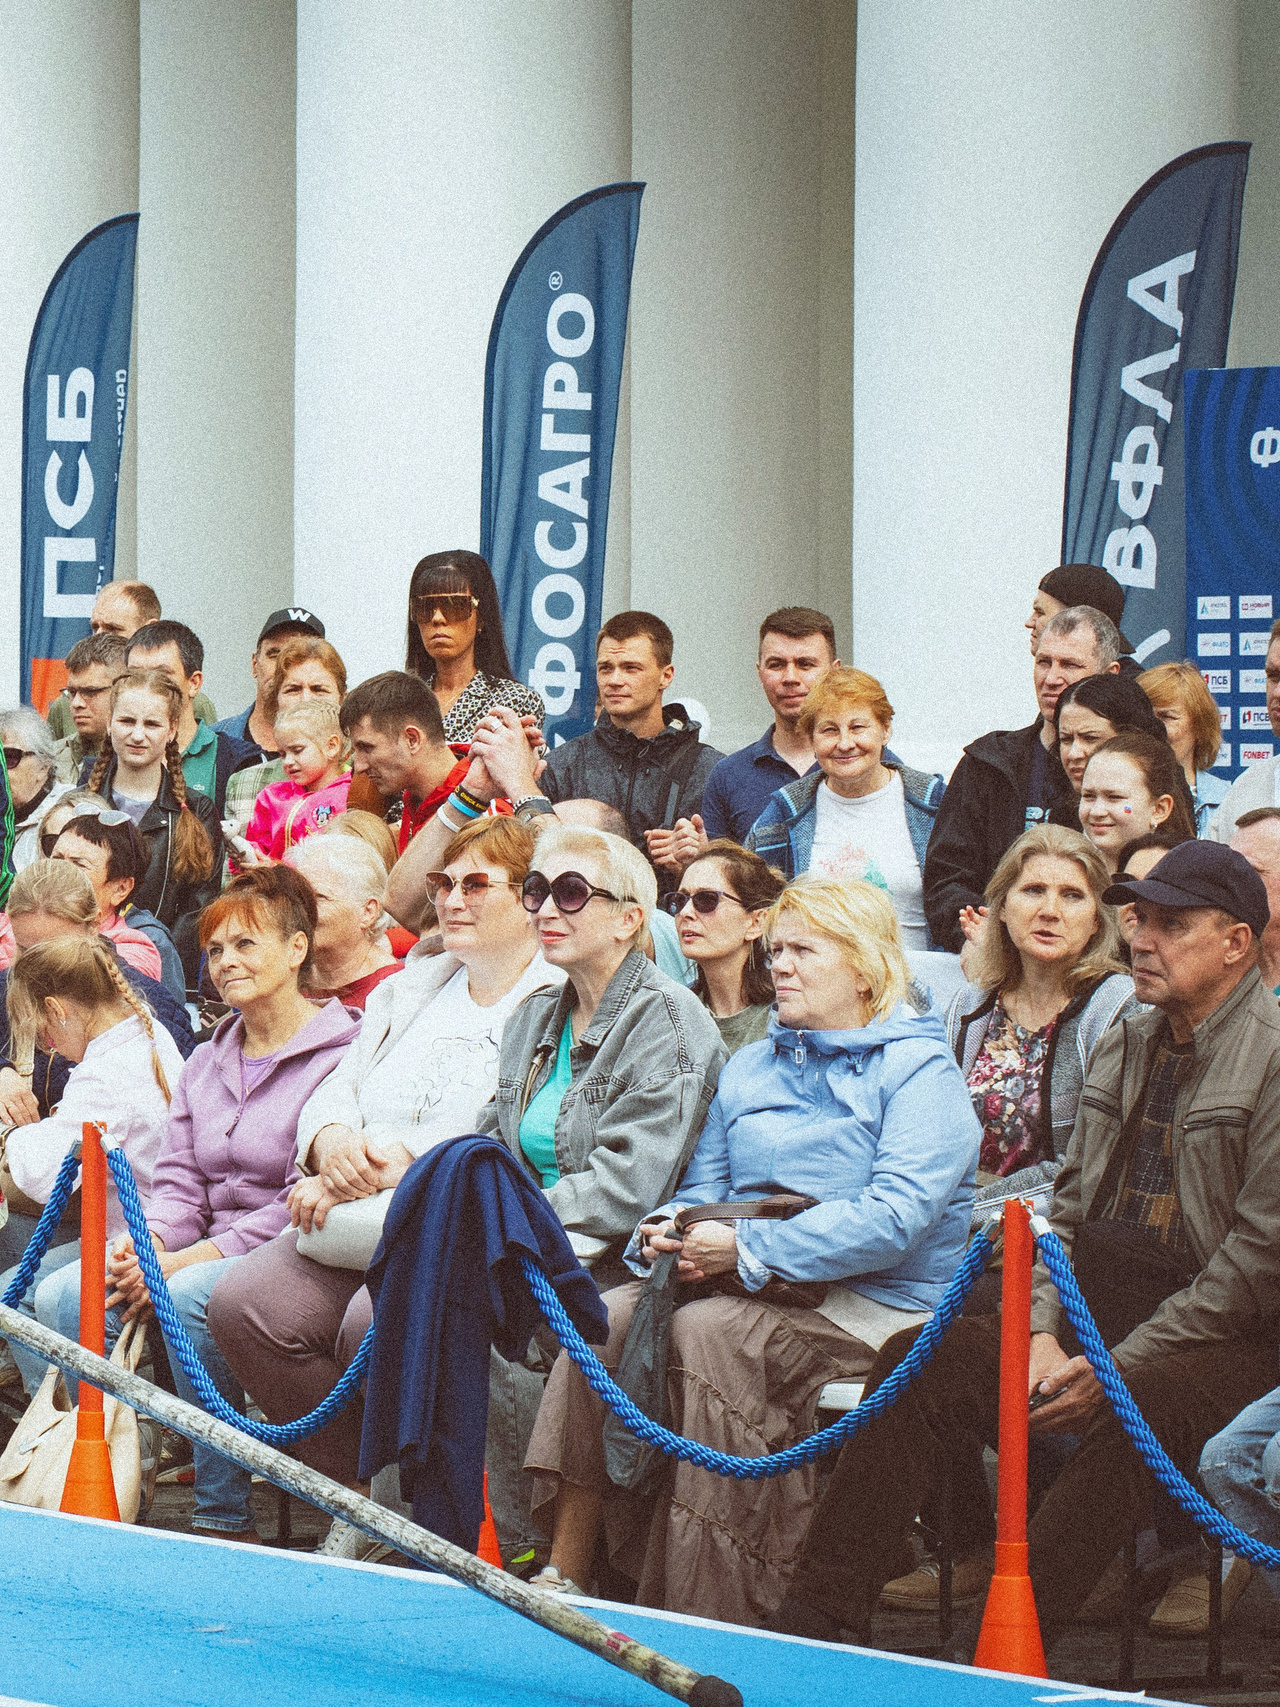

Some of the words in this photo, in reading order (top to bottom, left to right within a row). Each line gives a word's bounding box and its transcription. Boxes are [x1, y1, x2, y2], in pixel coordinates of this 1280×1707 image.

[1102, 249, 1197, 590] ВФЛА
[43, 366, 97, 618] ПСБ
[287, 608, 311, 623] W
[1211, 675, 1228, 685] ПСБ
[1243, 750, 1270, 760] FONBET
